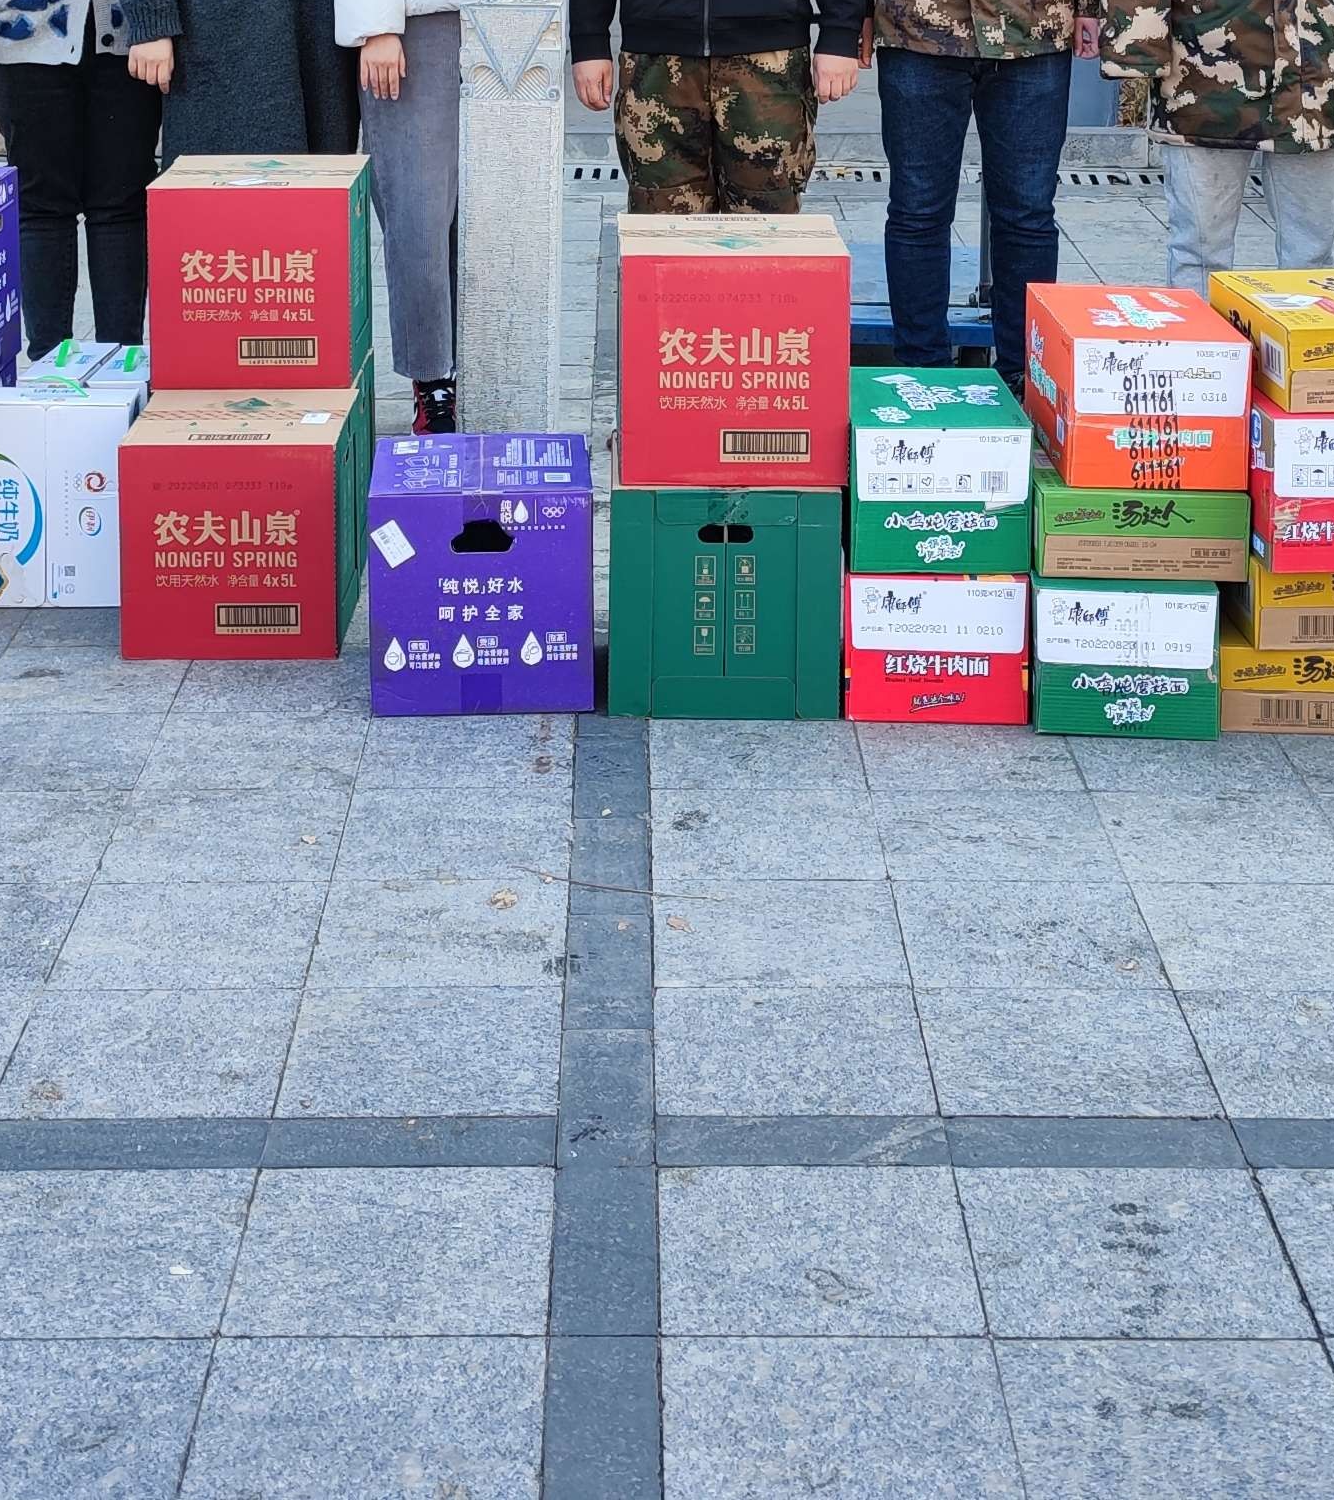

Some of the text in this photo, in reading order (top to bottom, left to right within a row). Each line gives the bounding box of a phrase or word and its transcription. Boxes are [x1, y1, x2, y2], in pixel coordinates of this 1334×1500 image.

[180, 249, 315, 283] 农夫山泉
[182, 288, 315, 304] NONGFU SPRING
[182, 309, 242, 322] 饮用天然水
[250, 309, 279, 322] 净含量
[658, 328, 812, 366] 农夫山泉
[659, 372, 810, 389] NONGFU SPRING
[659, 396, 727, 410] 饮用天然水
[735, 396, 769, 410] 净含量
[1112, 500, 1195, 529] 汤达人
[153, 510, 298, 546] 农夫山泉
[155, 552, 298, 568] NONGFU SPRING
[155, 574, 219, 587] 饮用天然水
[227, 574, 259, 587] 净含量
[438, 604, 524, 622] 呵护全家
[957, 625, 968, 634] 11
[977, 626, 1003, 635] 0210
[885, 654, 989, 676] 红烧牛肉面
